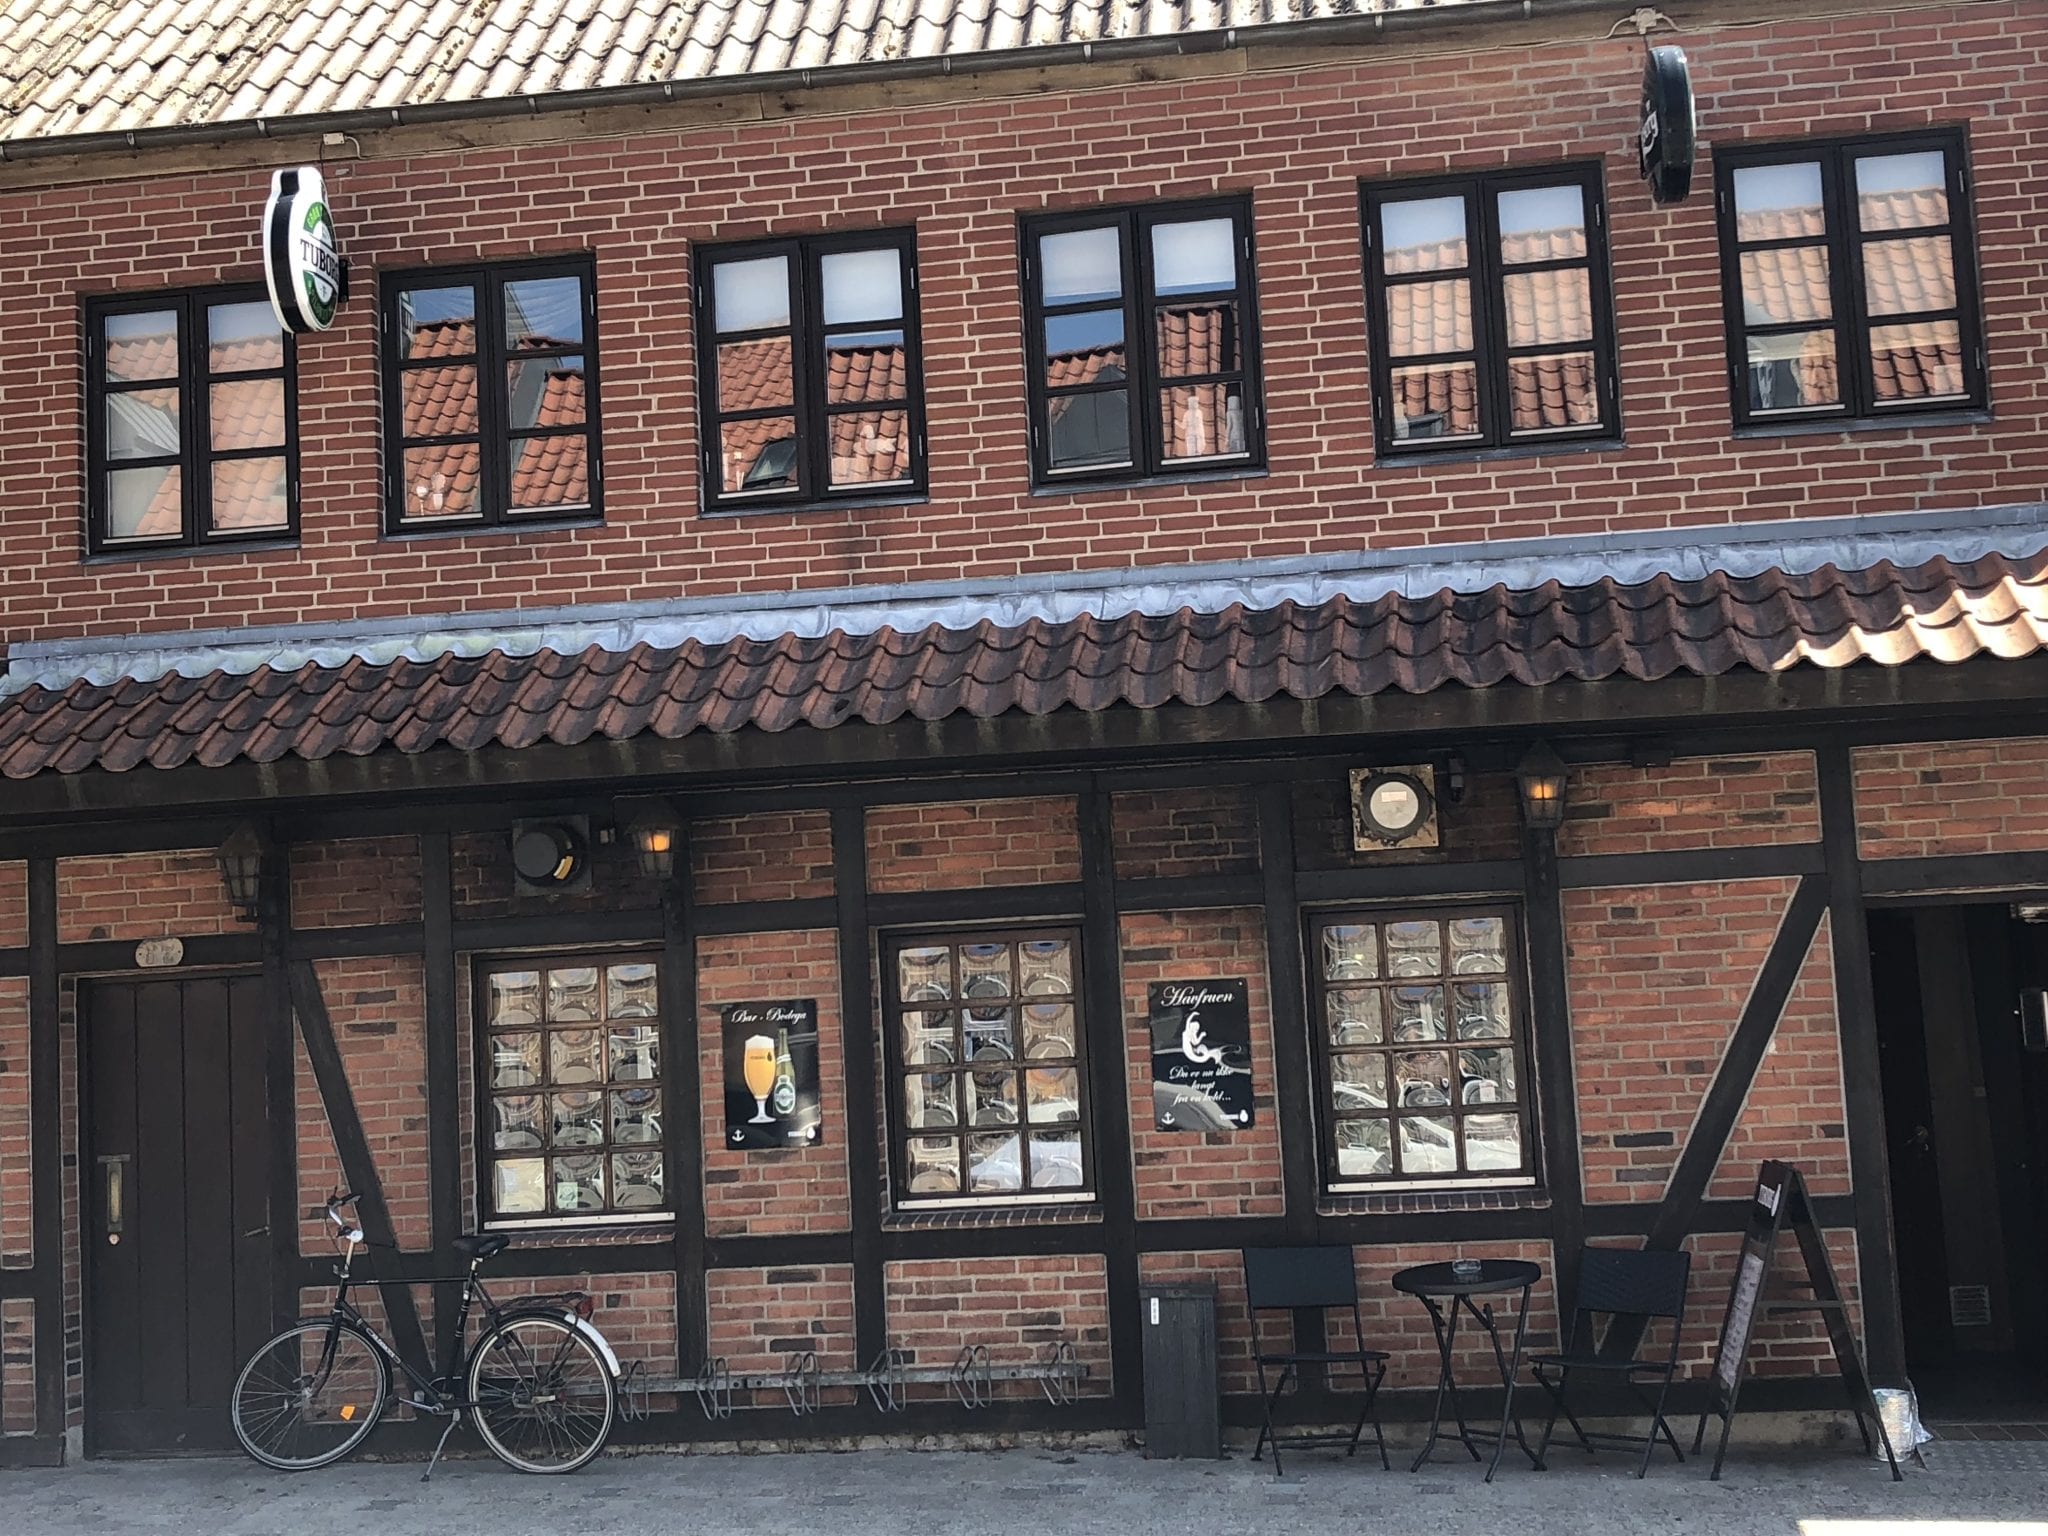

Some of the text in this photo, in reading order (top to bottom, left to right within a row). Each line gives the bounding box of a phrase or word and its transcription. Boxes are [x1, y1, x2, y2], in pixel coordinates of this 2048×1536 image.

[1161, 986, 1234, 1010] Havfruen
[731, 1007, 808, 1025] Bar Bodega
